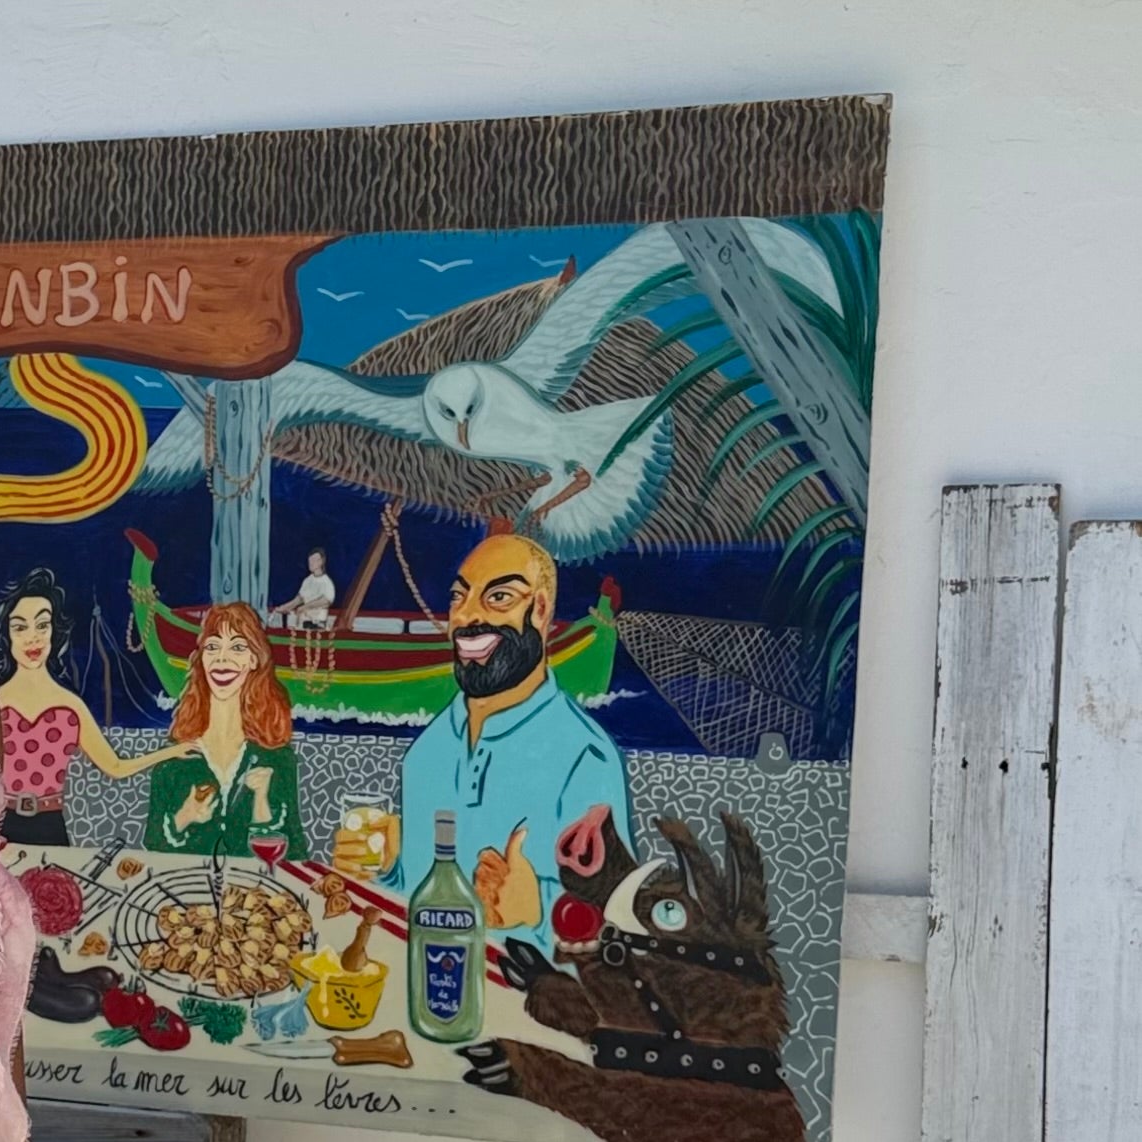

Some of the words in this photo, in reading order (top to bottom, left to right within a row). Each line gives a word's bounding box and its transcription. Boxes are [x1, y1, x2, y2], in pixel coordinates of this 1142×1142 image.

[419, 911, 474, 929] RICARD
[25, 1059, 84, 1084] asser
[101, 1056, 128, 1089] la
[133, 1070, 191, 1096] mer
[206, 1074, 250, 1100] sur
[264, 1067, 303, 1105] les
